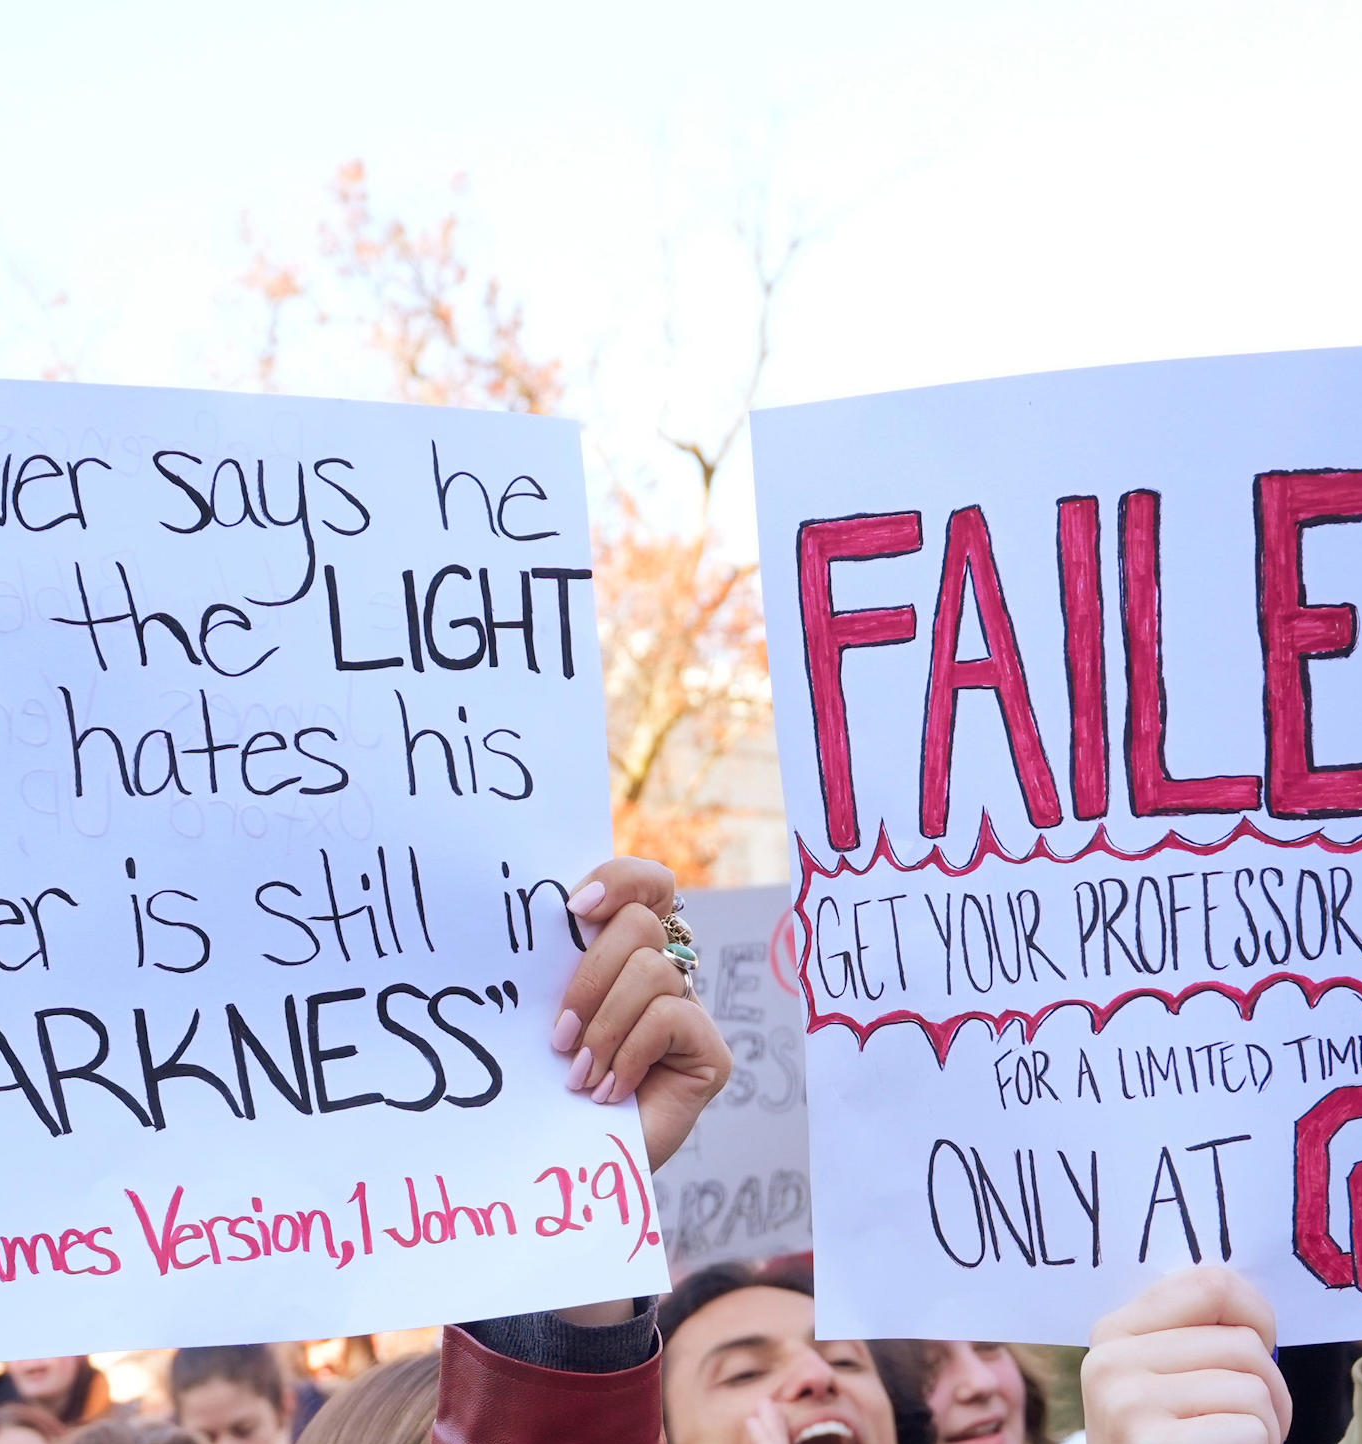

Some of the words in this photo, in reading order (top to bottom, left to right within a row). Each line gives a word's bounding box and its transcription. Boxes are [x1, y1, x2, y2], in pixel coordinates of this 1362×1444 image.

[155, 447, 373, 605] says
[431, 439, 561, 543] he
[50, 560, 281, 678] the
[323, 563, 593, 679] LIGHT
[59, 686, 351, 798] hates
[395, 690, 535, 801] his
[125, 856, 212, 973] is
[253, 845, 435, 965] still
[500, 861, 595, 954] in
[812, 893, 914, 1001] GET
[921, 880, 1066, 995] YOUR
[993, 1044, 1062, 1111] FOR
[1076, 1055, 1105, 1104] A
[1118, 1035, 1275, 1102] LIMITED
[382, 1171, 519, 1248] John
[927, 1136, 1103, 1270] ONLY
[1137, 1132, 1253, 1265] AT
